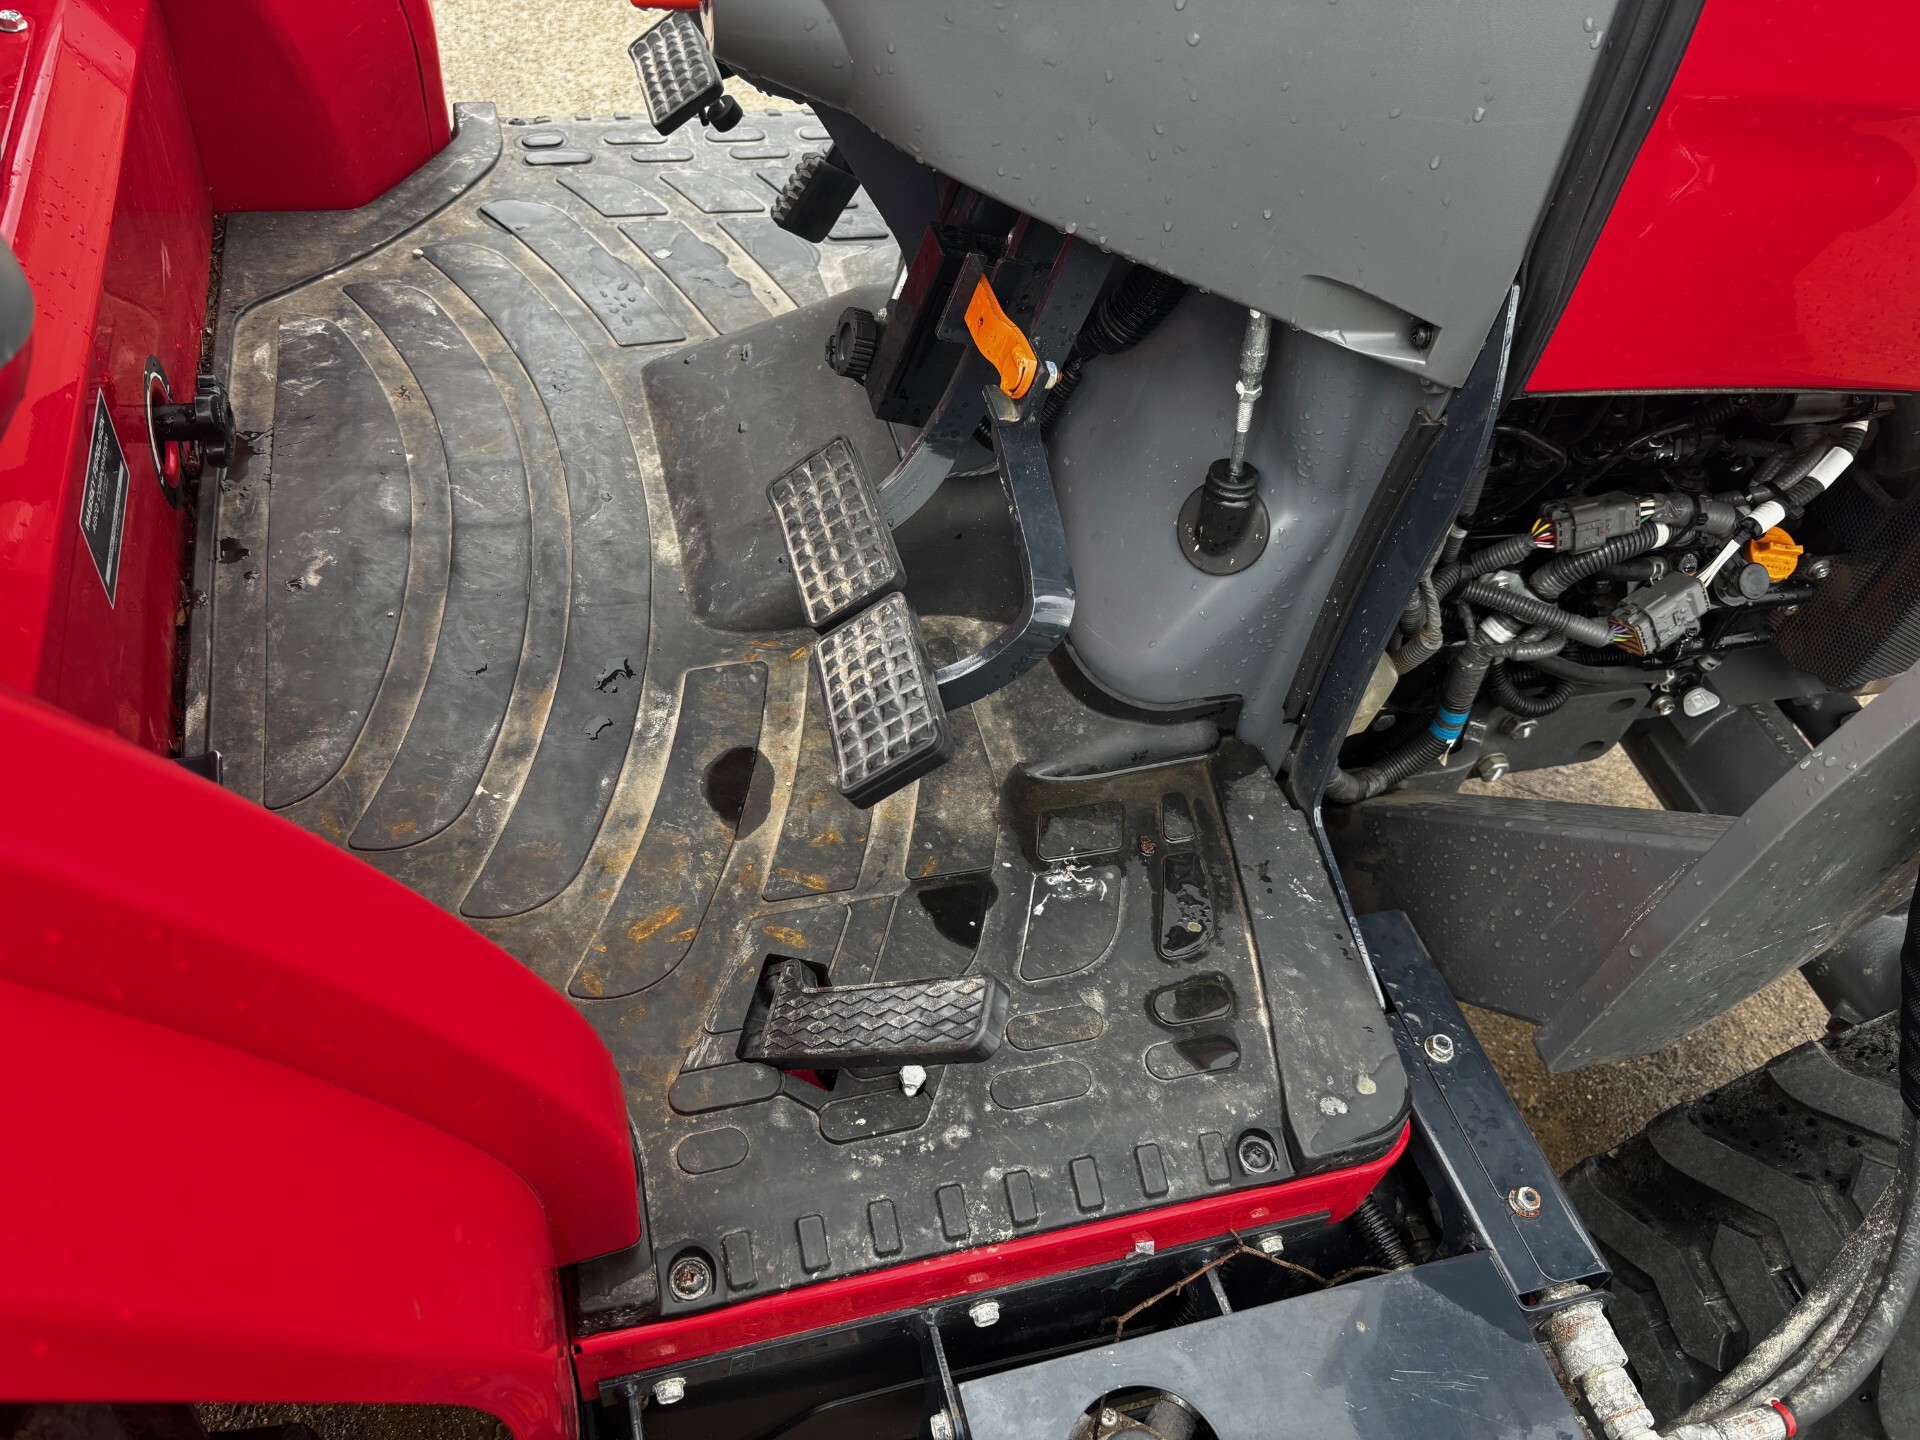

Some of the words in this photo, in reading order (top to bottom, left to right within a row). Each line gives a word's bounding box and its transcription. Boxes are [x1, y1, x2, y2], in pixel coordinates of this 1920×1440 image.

[85, 475, 96, 531] MASSEY
[93, 411, 105, 478] FERGUSON
[92, 502, 100, 534] AGCO
[97, 432, 109, 501] CORPORATION
